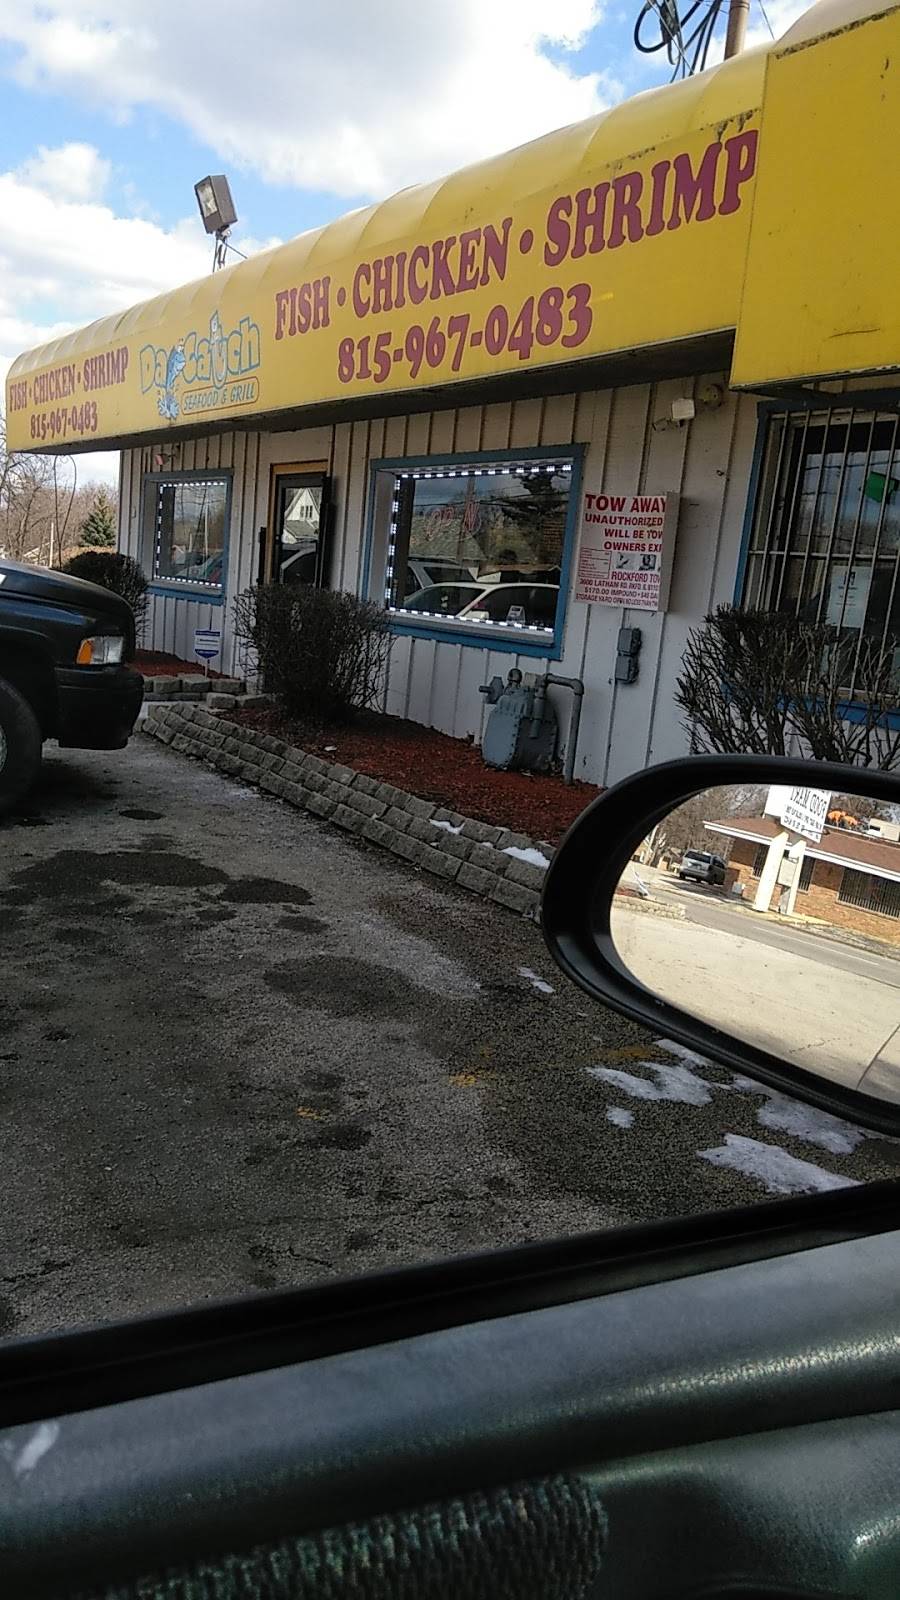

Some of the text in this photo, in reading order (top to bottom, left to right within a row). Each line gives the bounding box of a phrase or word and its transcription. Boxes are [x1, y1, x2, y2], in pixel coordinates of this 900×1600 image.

[274, 129, 759, 340] FISH CHICKEN SHRIMP
[337, 282, 594, 384] 815-967-0483
[9, 346, 129, 413] FISH CHICKEN SHRIMP
[183, 391, 219, 411] SEAFOOD
[230, 382, 256, 402] GRILL
[584, 493, 627, 513] TOW
[584, 513, 664, 527] UNAUTHORIZED
[604, 527, 630, 539] WILL
[632, 529, 644, 539] BE
[604, 541, 646, 552] OWNERS
[611, 571, 649, 583] ROCKFORD
